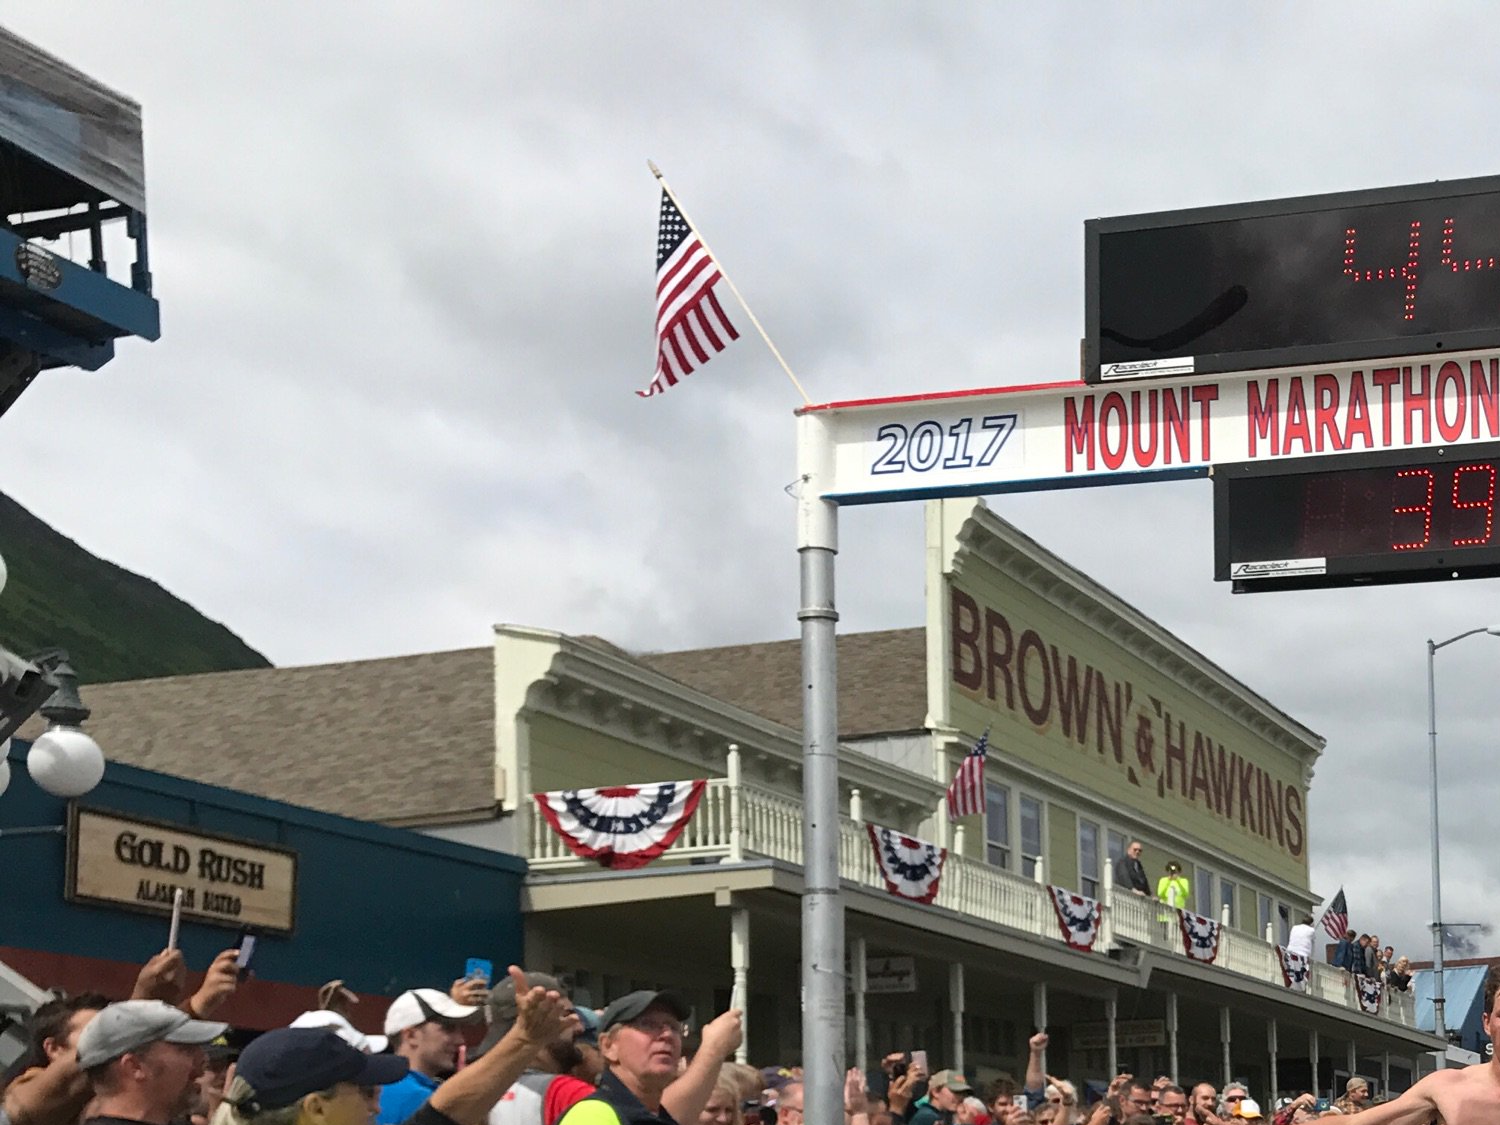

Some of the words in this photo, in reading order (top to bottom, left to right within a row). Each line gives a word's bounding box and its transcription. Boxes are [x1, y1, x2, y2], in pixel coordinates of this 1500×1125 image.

[871, 414, 1018, 475] 2017
[1064, 383, 1219, 473] MOUNT
[1247, 357, 1500, 458] MARATHON
[1165, 711, 1302, 857] HAWKINS
[114, 830, 191, 875] GOLD
[198, 848, 266, 890] RUSH
